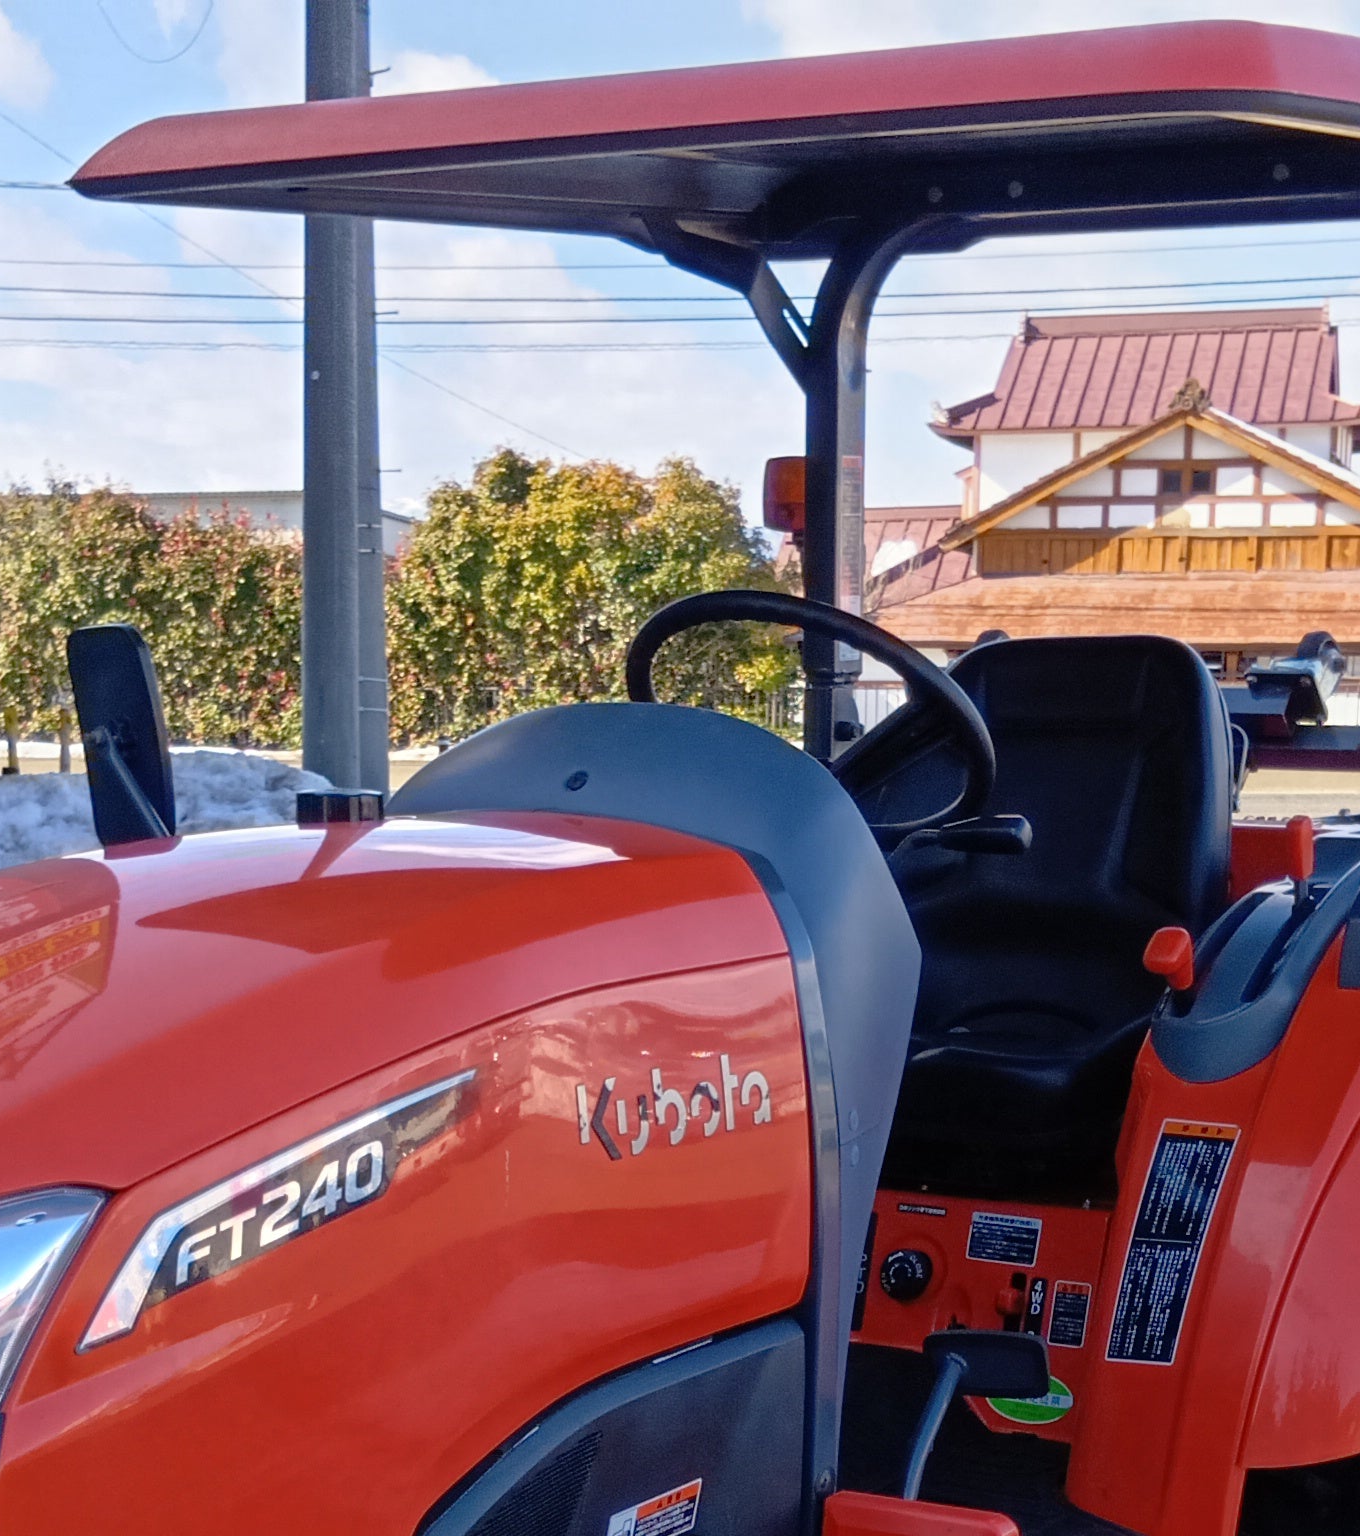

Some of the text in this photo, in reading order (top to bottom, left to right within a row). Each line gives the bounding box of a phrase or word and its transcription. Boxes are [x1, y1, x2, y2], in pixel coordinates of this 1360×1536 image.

[576, 1053, 772, 1161] Kubota
[175, 1139, 386, 1285] FT240
[1030, 1280, 1044, 1315] 4WD
